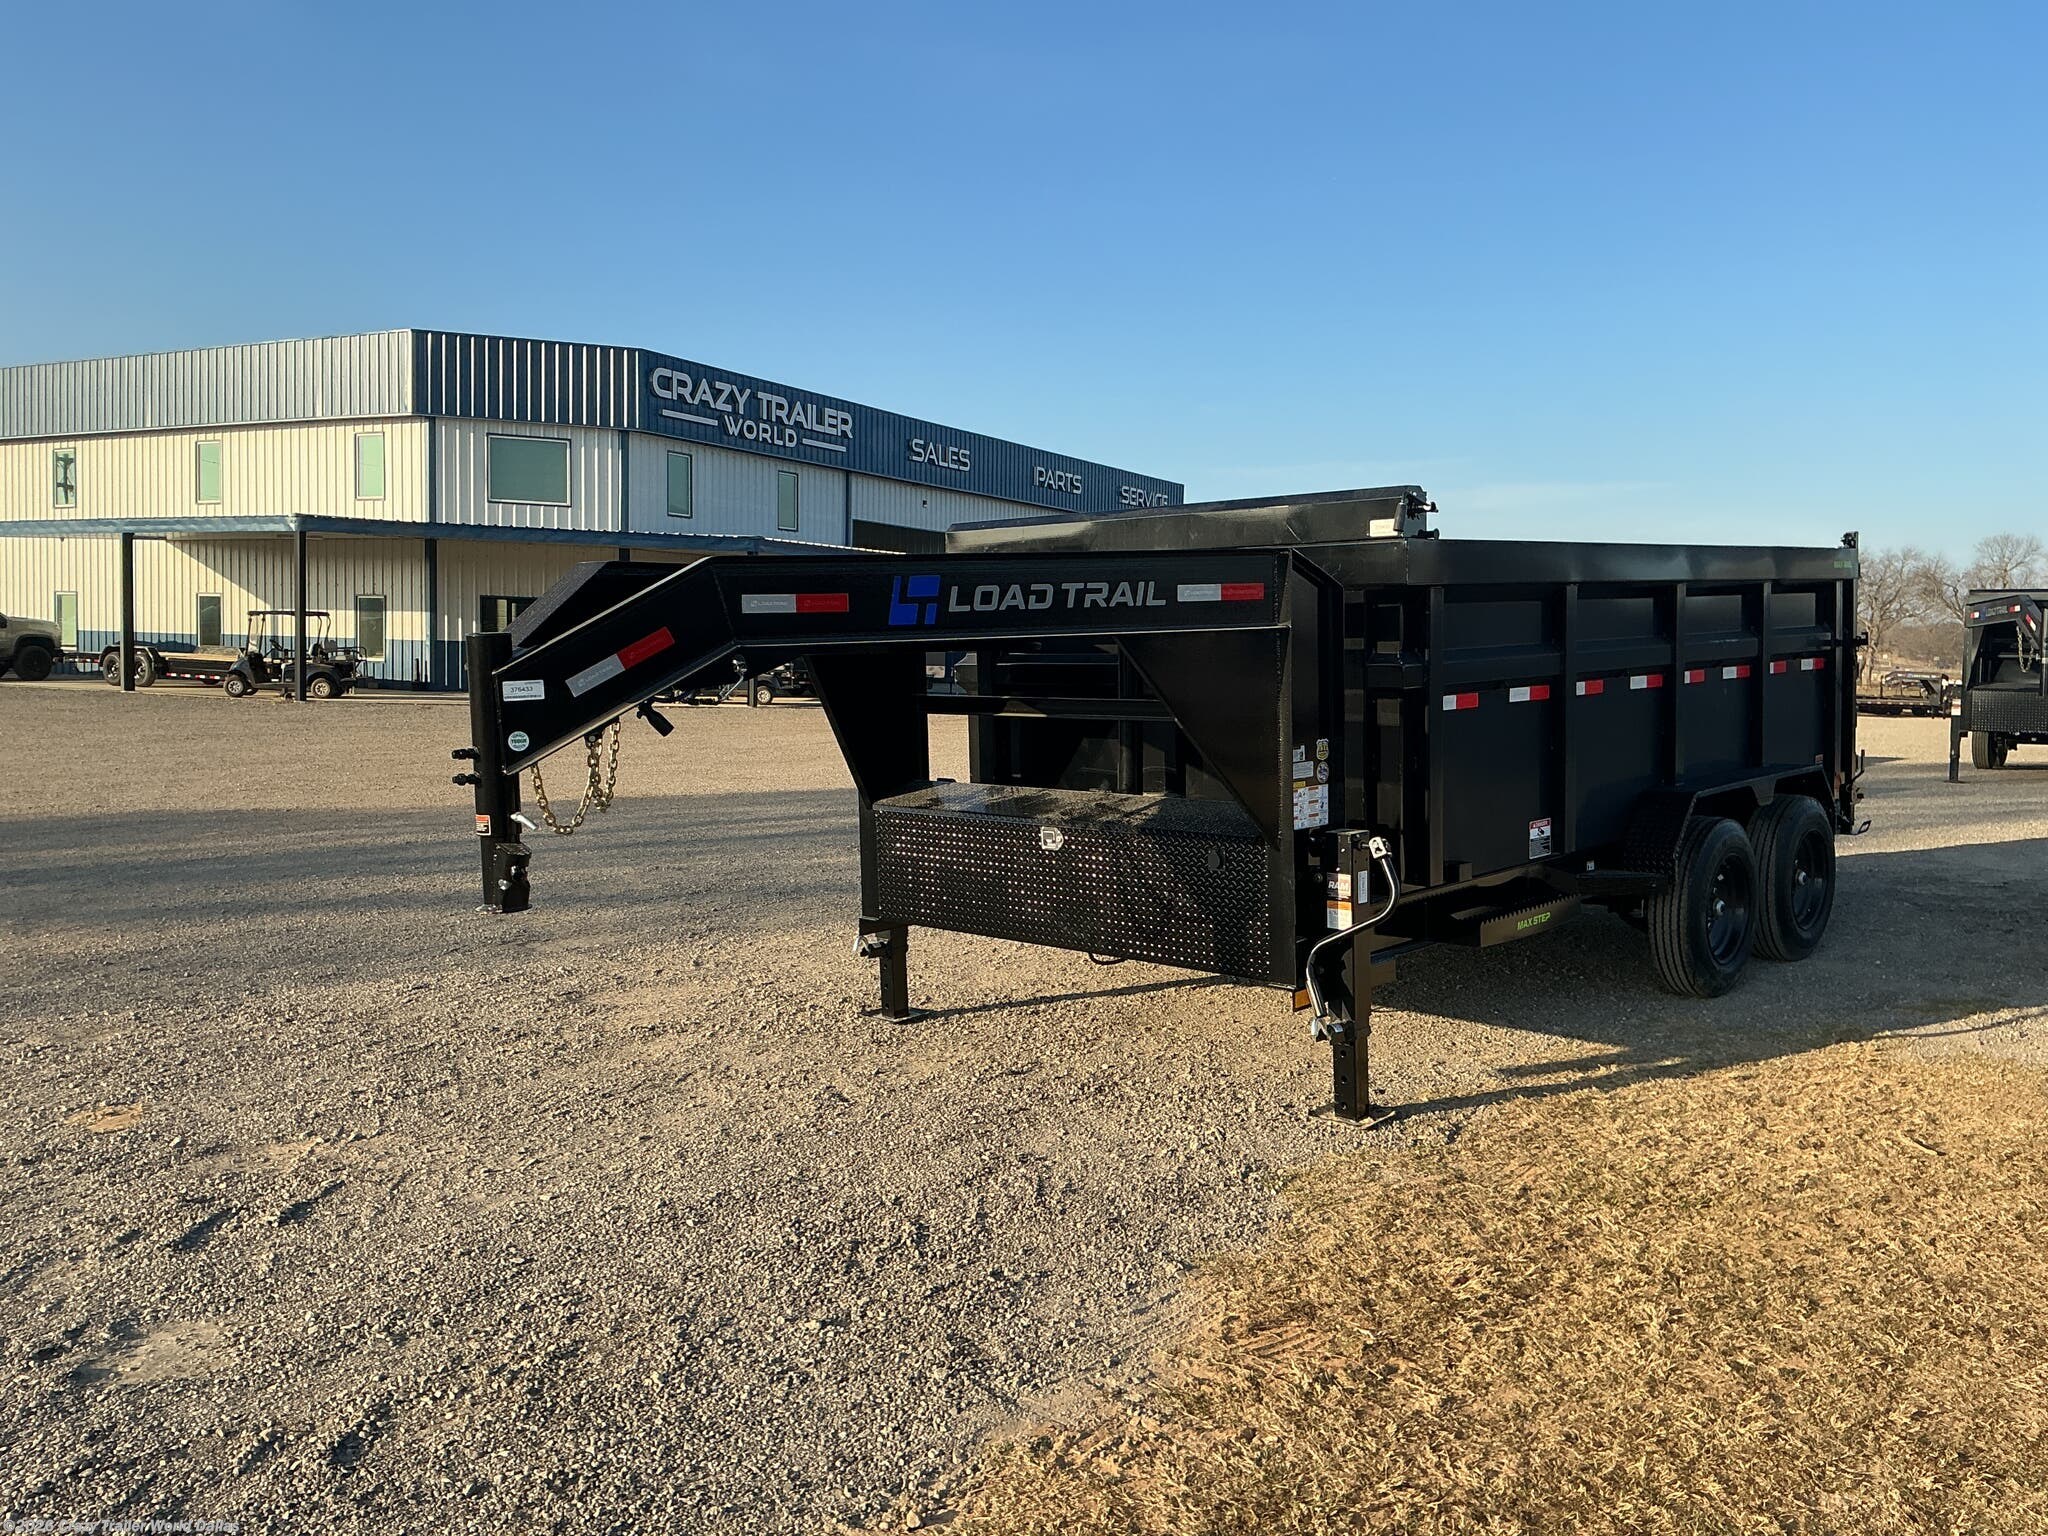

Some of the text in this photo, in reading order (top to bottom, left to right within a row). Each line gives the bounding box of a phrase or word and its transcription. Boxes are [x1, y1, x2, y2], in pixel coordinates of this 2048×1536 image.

[652, 367, 853, 439] CRAZY TRAILER
[724, 415, 798, 448] WORLD
[910, 438, 971, 472] SALES
[1034, 466, 1082, 495] PARTS
[948, 581, 1167, 612] LOAD TRAIL
[1328, 881, 1349, 891] RAM
[1517, 911, 1551, 930] MAX STEP
